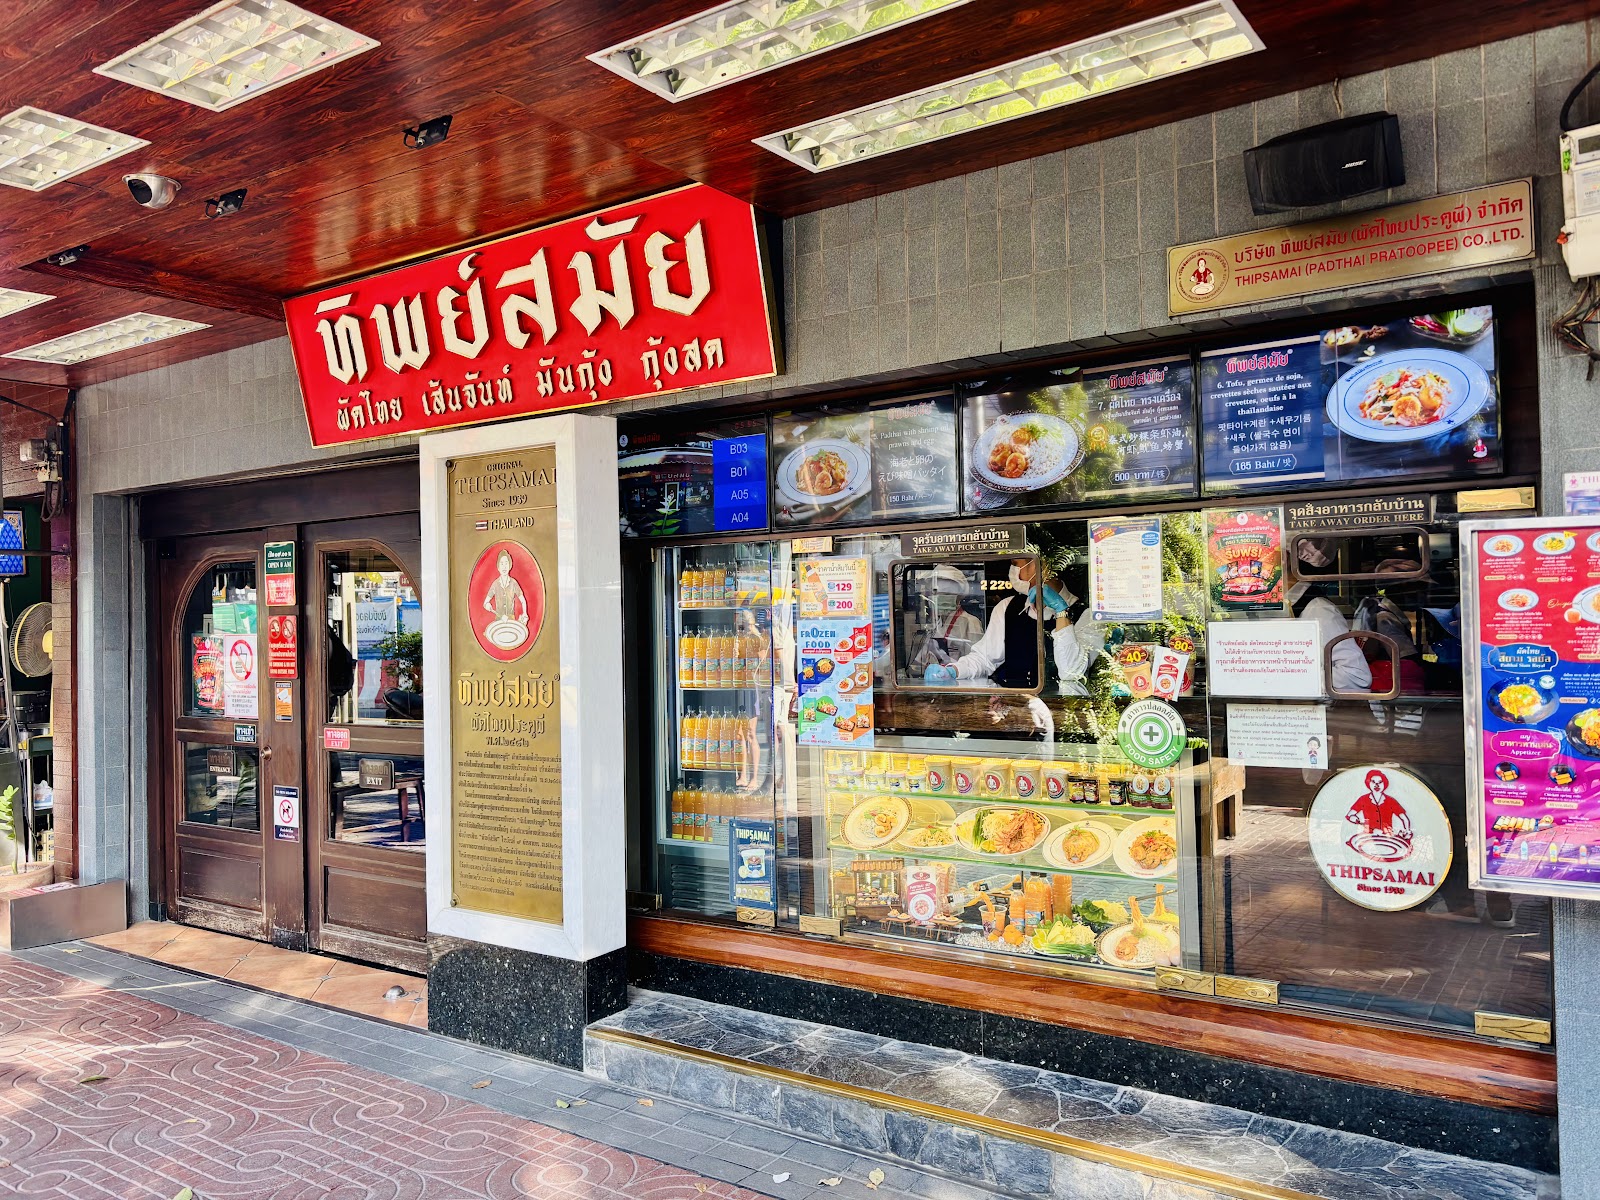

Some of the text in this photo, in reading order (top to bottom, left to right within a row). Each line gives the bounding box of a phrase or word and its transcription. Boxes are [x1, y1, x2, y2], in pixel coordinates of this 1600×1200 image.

[1235, 244, 1275, 263] บริษัท
[1281, 231, 1348, 255] ทิพย์สมัย
[1478, 197, 1523, 219] จำกัด
[1235, 266, 1301, 287] THIPSAMAI
[1305, 255, 1365, 276] (PADTHAI
[1370, 237, 1458, 263] PRATOOPEE)
[1463, 228, 1524, 248] CO.,LTD.
[314, 214, 711, 384] ทิพย์สมัย
[1226, 352, 1289, 373] ทิพย์สมัย
[337, 336, 724, 431] ผัดไทย เส้นจันท์ มันกุ้ง กุ้งสด
[1108, 369, 1165, 389] ทิพย์สมัย
[1247, 377, 1273, 386] germes
[1286, 372, 1304, 382] soja,
[1210, 390, 1241, 400] crevettes
[1243, 387, 1268, 396] sèches
[1269, 384, 1296, 392] sautées
[1098, 389, 1181, 411] 7. ผัดไทย ทรงเครื่อง
[1225, 399, 1259, 408] crevettes,
[1260, 395, 1281, 403] oeufs
[1289, 392, 1297, 400] la
[1237, 404, 1284, 416] thaïlandaise
[903, 428, 917, 436] with
[918, 425, 939, 435] shrimp
[730, 443, 748, 454] B03
[486, 460, 523, 471] ORIGINAL
[731, 466, 748, 477] B01
[1235, 461, 1252, 471] 165
[1255, 459, 1275, 469] Baht
[454, 467, 557, 495] THIPSAMAI
[1114, 472, 1130, 481] 500
[482, 494, 528, 508] Since 1939
[731, 489, 749, 500] A05
[1289, 497, 1425, 520] จุดสั่งอาหารกลับบ้าน
[490, 516, 535, 531] THAILAND
[731, 512, 749, 523] A04
[1289, 513, 1424, 529] TAKE AWAY ORDER HERE
[912, 528, 1010, 547] จุดรับอาหารกลับบ้าน
[934, 545, 956, 553] AWAY
[836, 583, 852, 592] 129
[990, 580, 1013, 591] 226
[836, 601, 853, 609] 200
[800, 627, 836, 639] FROZEN
[805, 640, 831, 648] FOOD
[1174, 640, 1189, 652] 80
[1126, 651, 1141, 663] 40
[1127, 701, 1176, 721] อาหารปลอดภัย
[470, 711, 545, 739] ผัดไทยประตูผี
[1125, 743, 1178, 765] FOOD SAFETY
[209, 765, 231, 773] ENTRANCE
[366, 776, 383, 786] EXIT
[735, 828, 770, 842] THIPSAMAI
[1326, 863, 1436, 886] THIPSAMAI
[1356, 883, 1405, 895] Since 1939
